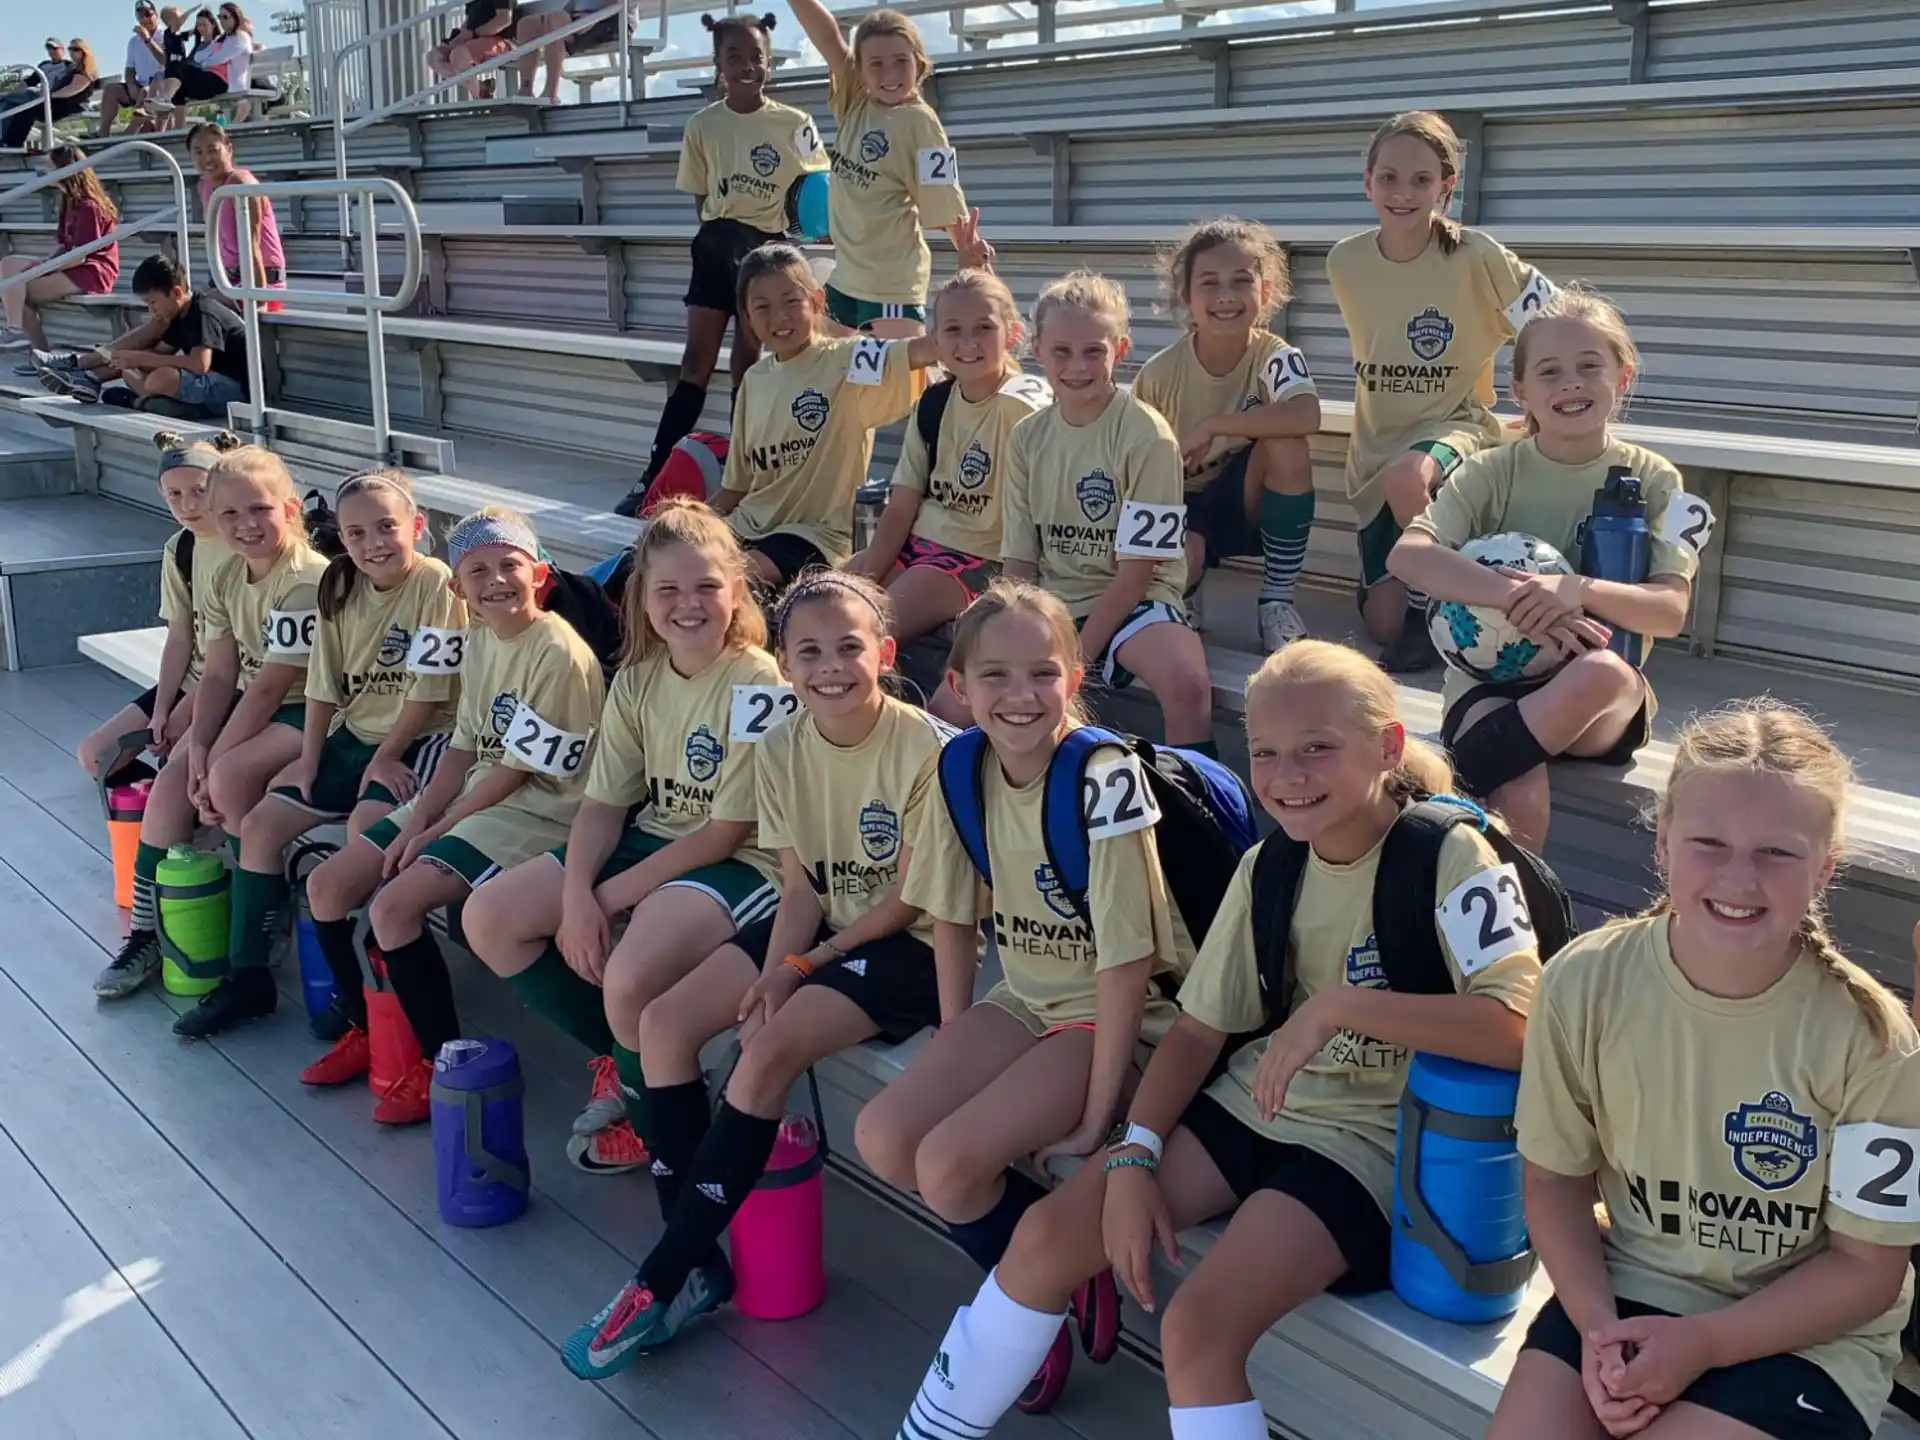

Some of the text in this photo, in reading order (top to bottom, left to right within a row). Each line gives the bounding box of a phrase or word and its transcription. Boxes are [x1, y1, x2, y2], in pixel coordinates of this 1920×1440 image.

[731, 173, 778, 193] NOVANT
[1381, 365, 1456, 379] NOVANT
[1380, 379, 1446, 394] HEALTH
[1050, 524, 1117, 542] NOVANT
[1050, 540, 1109, 557] HEALTH
[514, 718, 587, 772] 218
[674, 782, 714, 803] OVAN
[1460, 875, 1532, 950] 23
[1012, 915, 1092, 943] NOVAN
[1012, 936, 1098, 962] HEALTH
[1728, 1129, 1815, 1158] INDEPENDENCE
[1689, 1185, 1818, 1231] NOVANT
[1689, 1214, 1800, 1258] HEALTH
